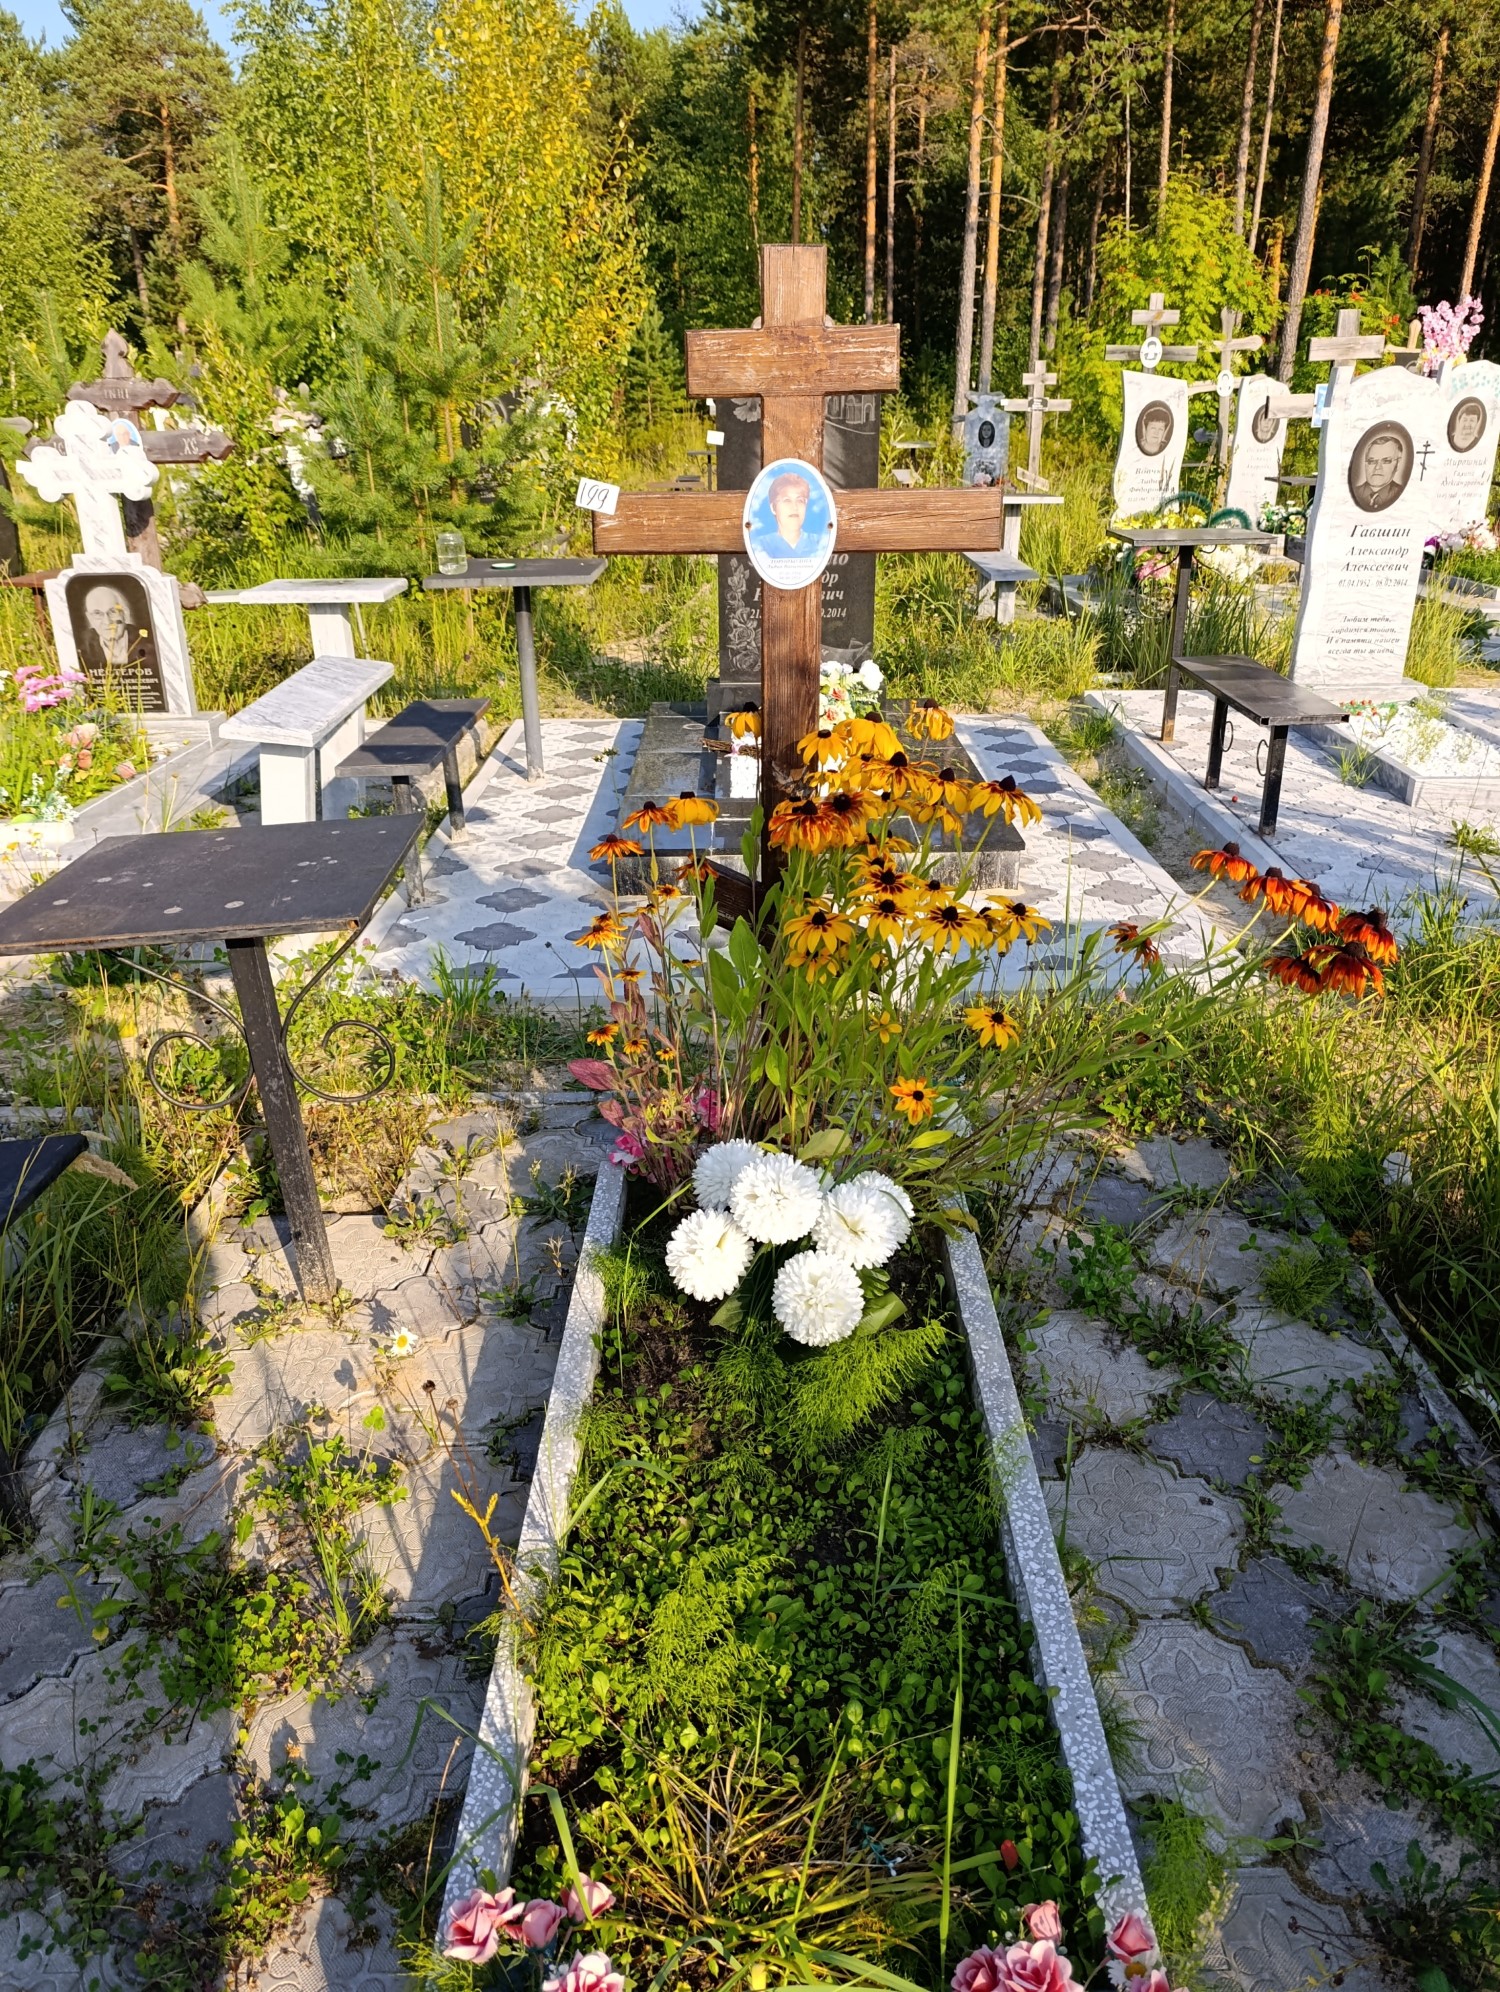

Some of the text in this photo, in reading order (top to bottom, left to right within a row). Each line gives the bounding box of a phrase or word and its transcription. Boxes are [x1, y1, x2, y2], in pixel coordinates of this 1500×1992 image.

[580, 482, 610, 509] 199
[1350, 524, 1411, 537] Гавшин
[1345, 546, 1409, 558] Александр
[1340, 562, 1409, 572] Алексеевич
[89, 668, 153, 677] НЕТЕРОВ
